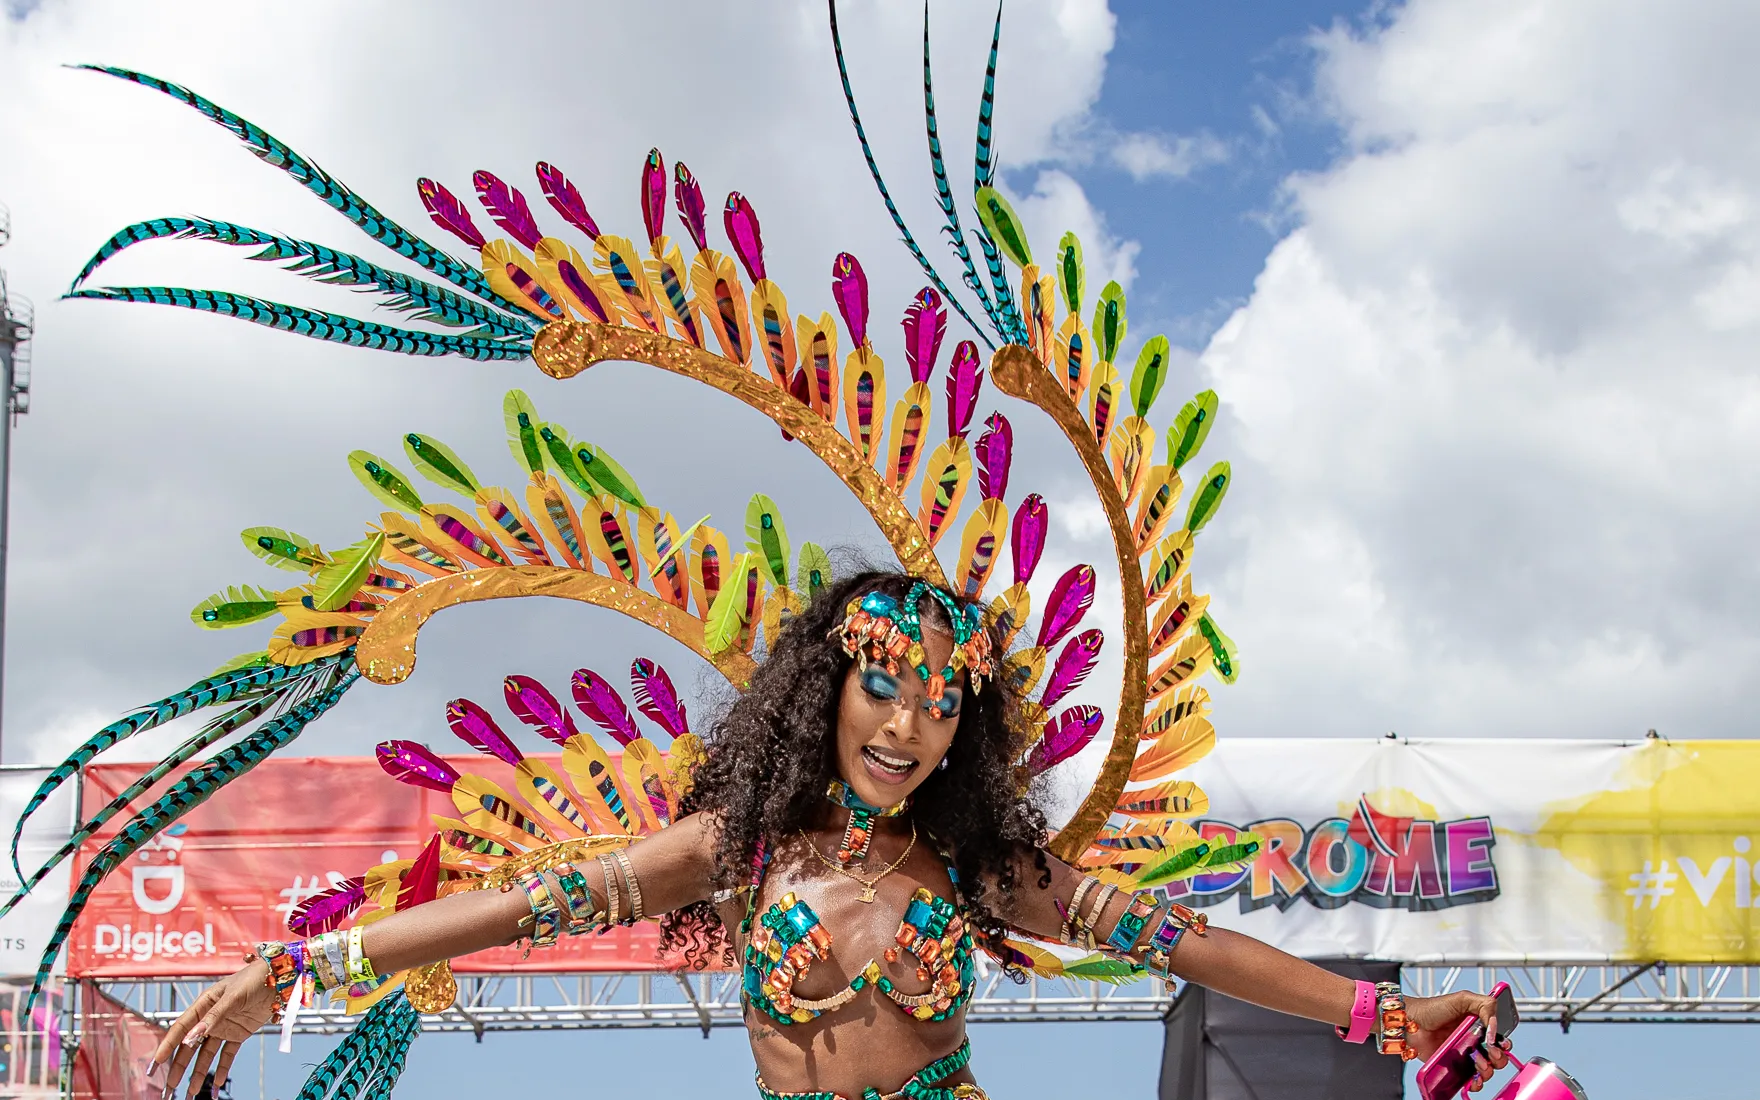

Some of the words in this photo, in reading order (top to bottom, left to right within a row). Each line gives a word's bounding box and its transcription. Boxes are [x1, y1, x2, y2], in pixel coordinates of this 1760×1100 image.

[1136, 816, 1497, 906] DROME
[1624, 836, 1760, 910] #vi
[95, 923, 216, 962] Digicel
